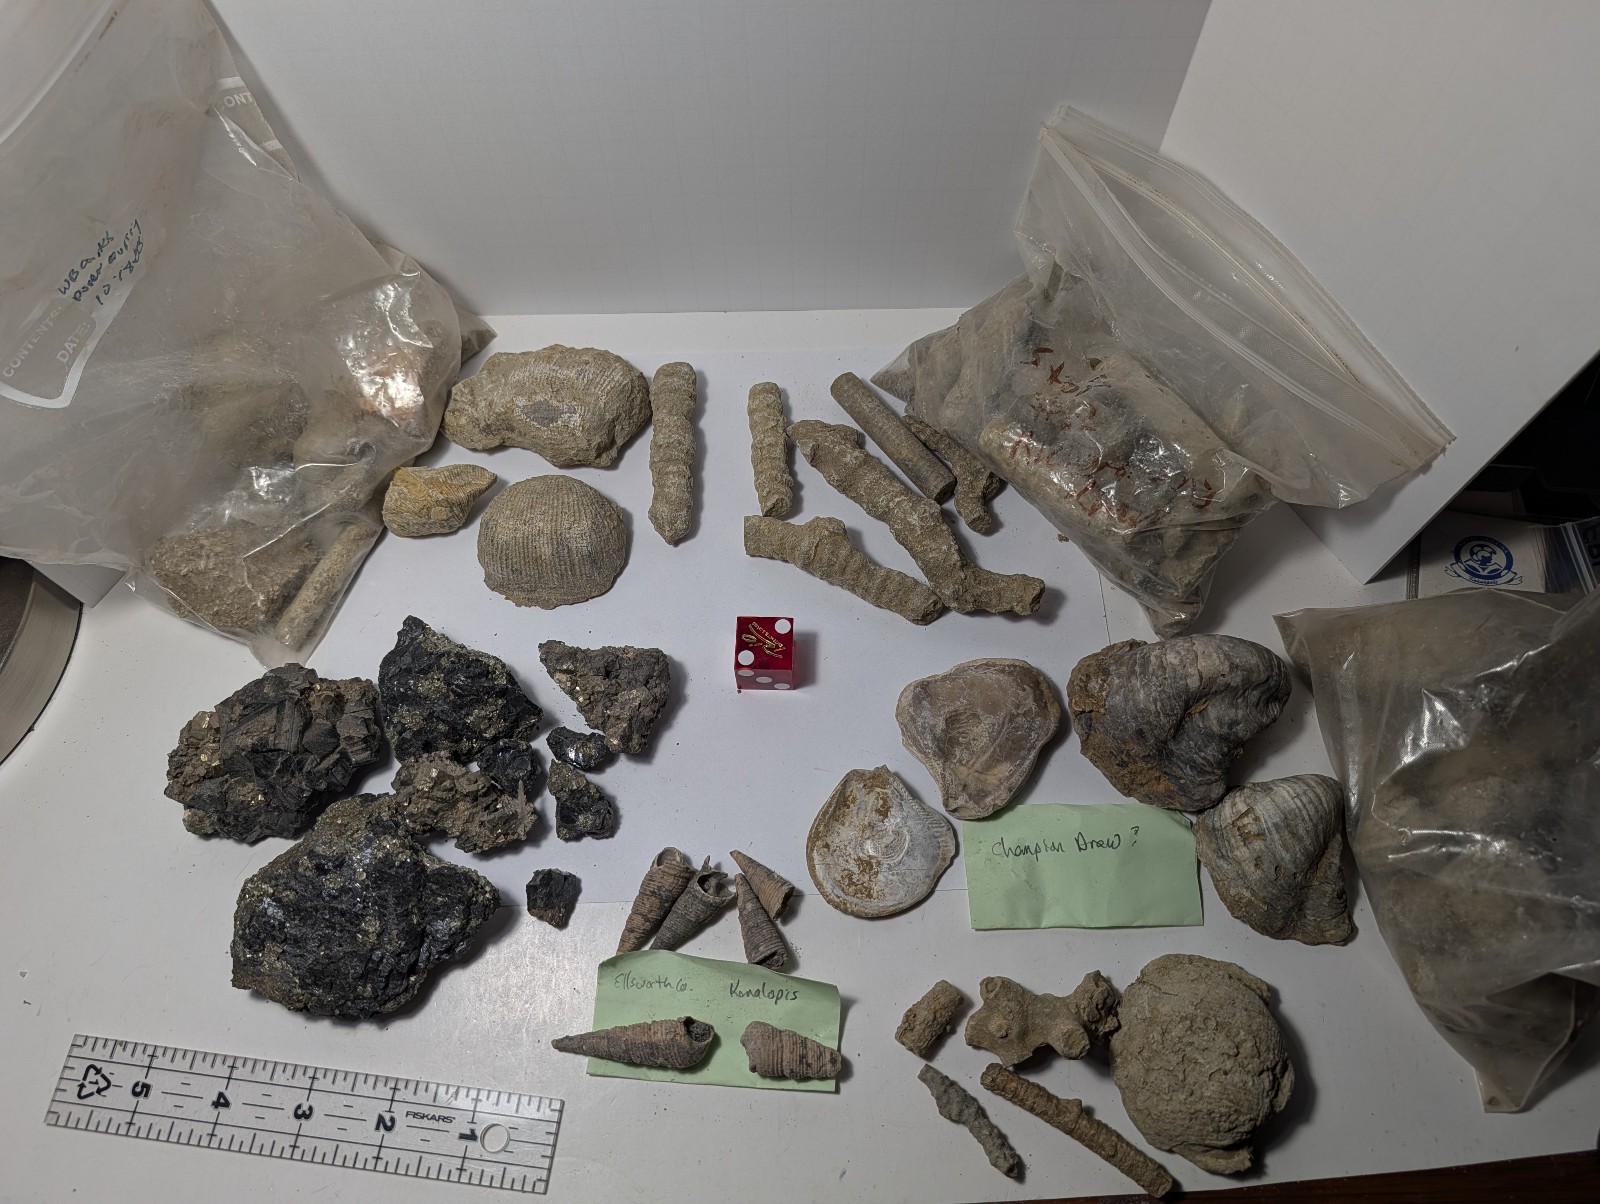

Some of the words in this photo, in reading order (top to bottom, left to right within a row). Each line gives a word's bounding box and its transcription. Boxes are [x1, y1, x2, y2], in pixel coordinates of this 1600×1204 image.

[131, 1080, 152, 1098] 5
[211, 1090, 232, 1110] 4
[293, 1102, 314, 1121] 3
[405, 1110, 456, 1124] FISKARS
[374, 1113, 396, 1132] 2
[458, 1127, 479, 1142] 1
